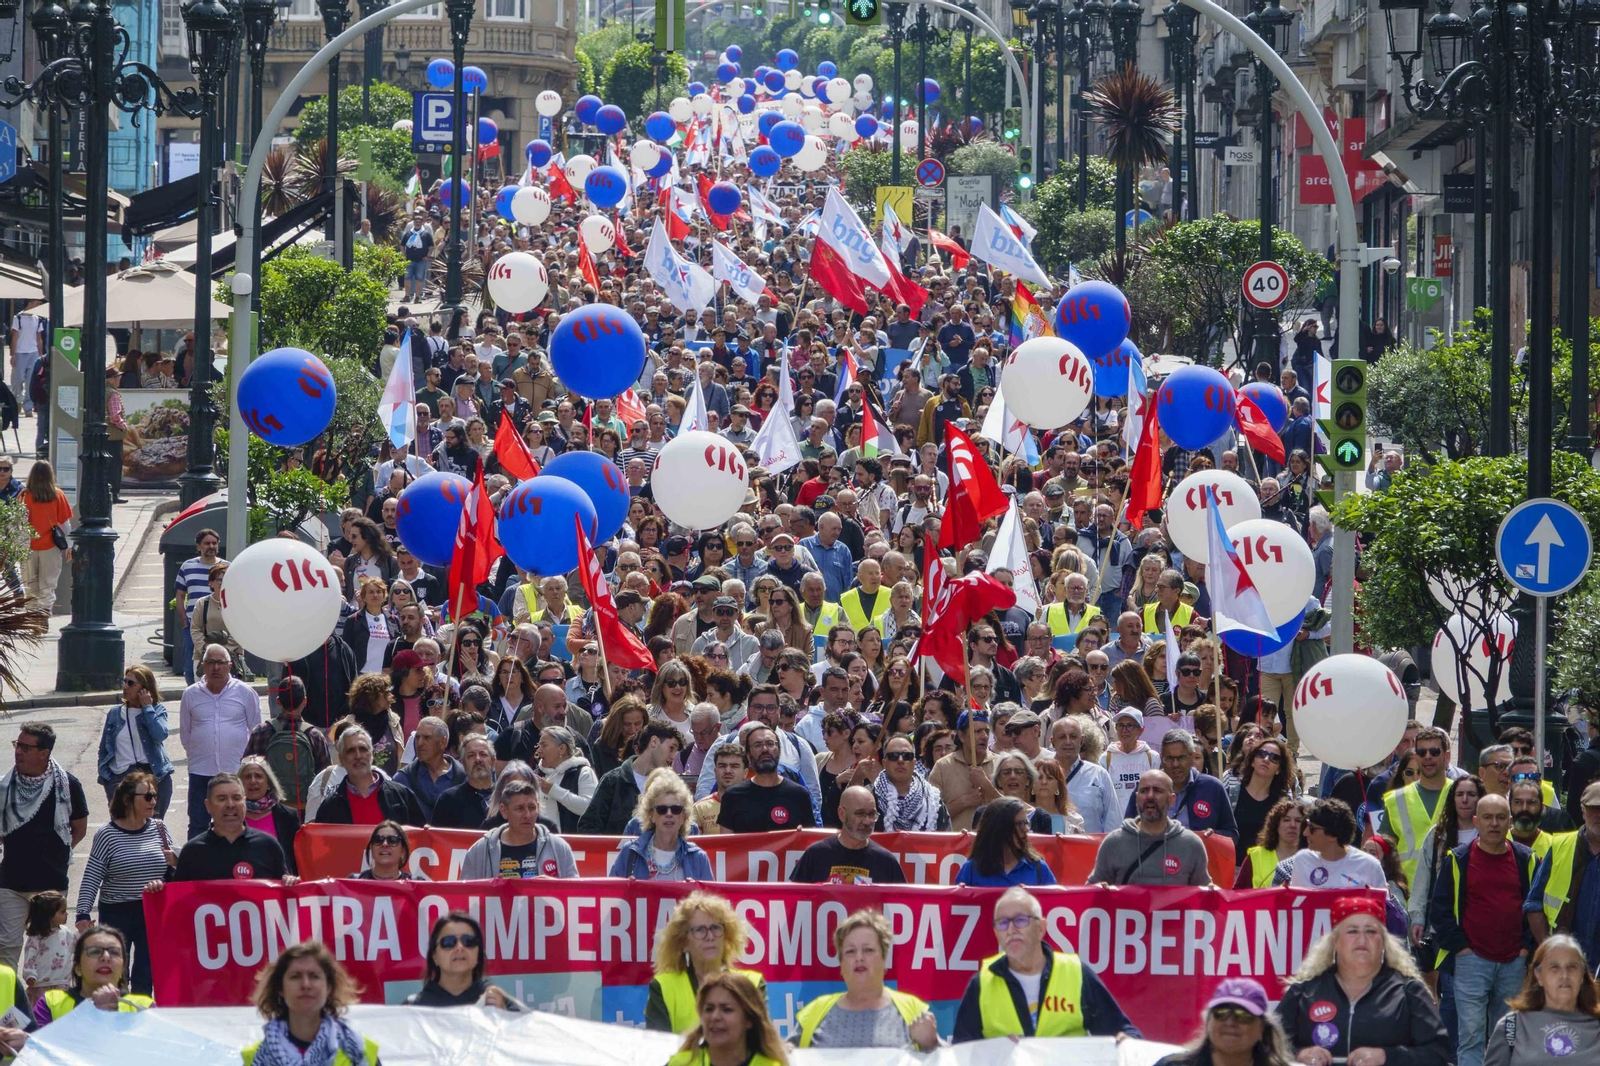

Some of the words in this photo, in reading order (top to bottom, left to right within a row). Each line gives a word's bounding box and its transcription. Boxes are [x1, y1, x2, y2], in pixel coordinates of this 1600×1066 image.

[428, 100, 451, 128] P
[542, 118, 550, 131] P
[904, 127, 917, 135] CIG
[1230, 148, 1254, 160] hoss
[589, 172, 613, 189] CIG
[600, 224, 615, 242] CIG
[832, 213, 875, 263] bng
[1253, 276, 1279, 293] 40
[1061, 297, 1099, 325] CIG
[573, 312, 624, 344] CIG
[1057, 353, 1090, 395] CIG
[704, 444, 744, 481] CIG
[1185, 483, 1234, 511] CIG
[1231, 535, 1284, 565] IG
[271, 558, 330, 593] CIG
[1119, 773, 1140, 782] 1985
[774, 808, 786, 819] CIG
[1196, 803, 1209, 813] CIG
[237, 865, 251, 877] CIG
[1165, 859, 1180, 871] CIG
[193, 895, 403, 971] CONTRA
[883, 903, 981, 972] PAZ
[1045, 895, 1338, 977] SOBERANÍA
[1044, 995, 1076, 1015] CIG
